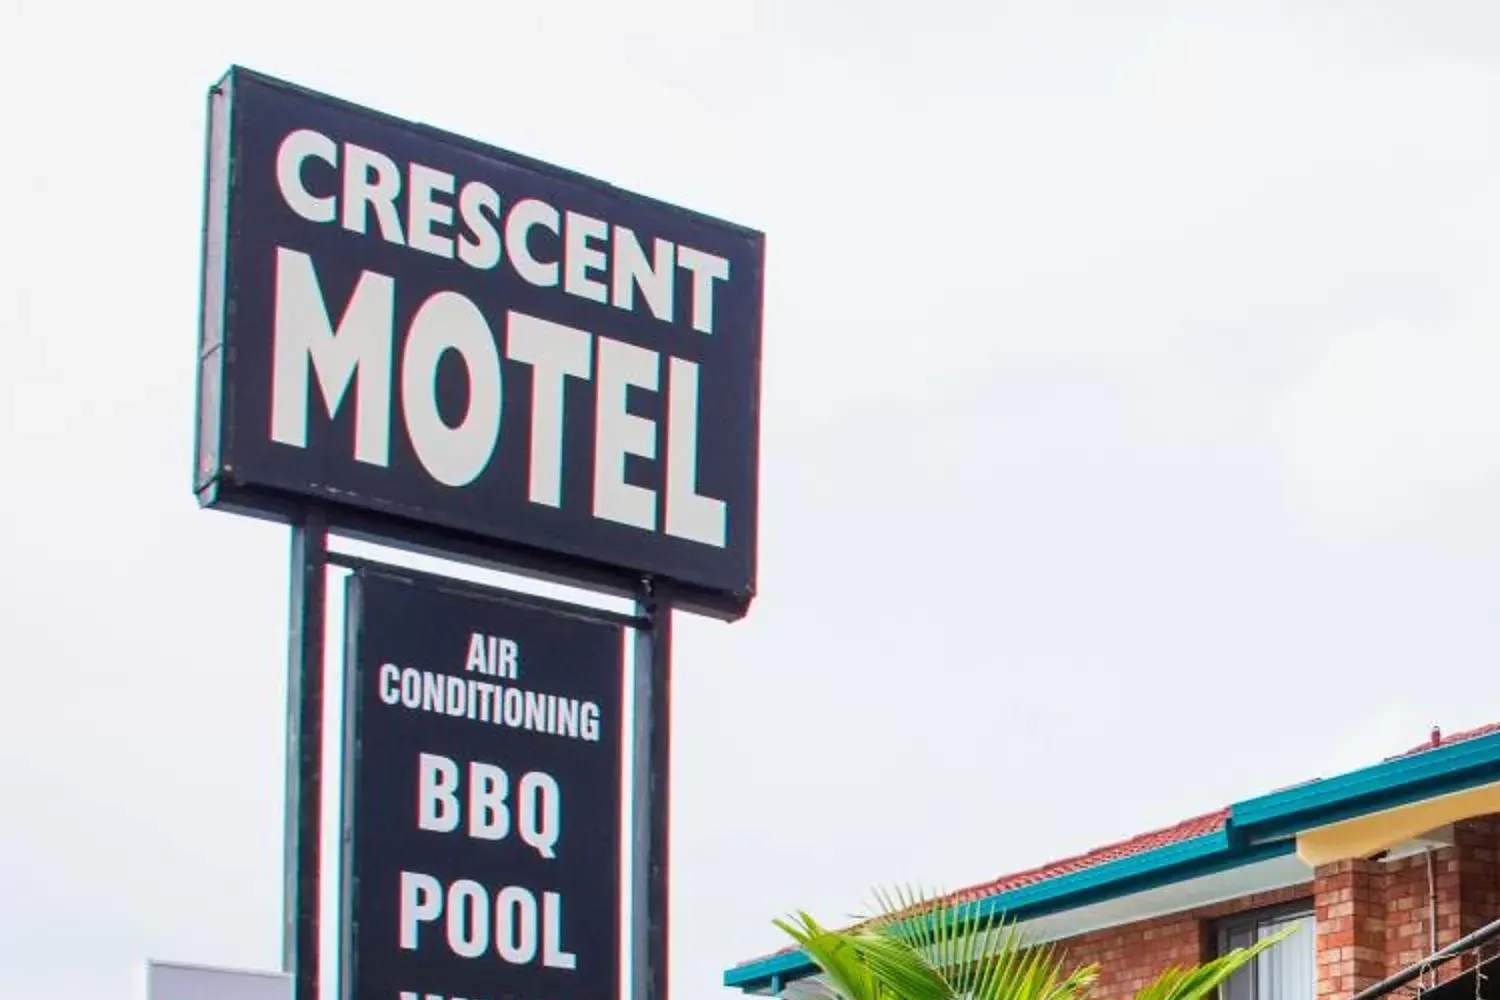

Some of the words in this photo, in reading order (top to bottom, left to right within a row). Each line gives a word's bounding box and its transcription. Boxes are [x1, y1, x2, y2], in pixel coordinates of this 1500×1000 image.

[275, 128, 730, 335] CRESCENT
[270, 245, 727, 549] MOTEL
[379, 663, 600, 742] CONDITIONING
[465, 632, 518, 680] AIR
[418, 752, 560, 859] BBQ
[399, 870, 577, 970] POOL
